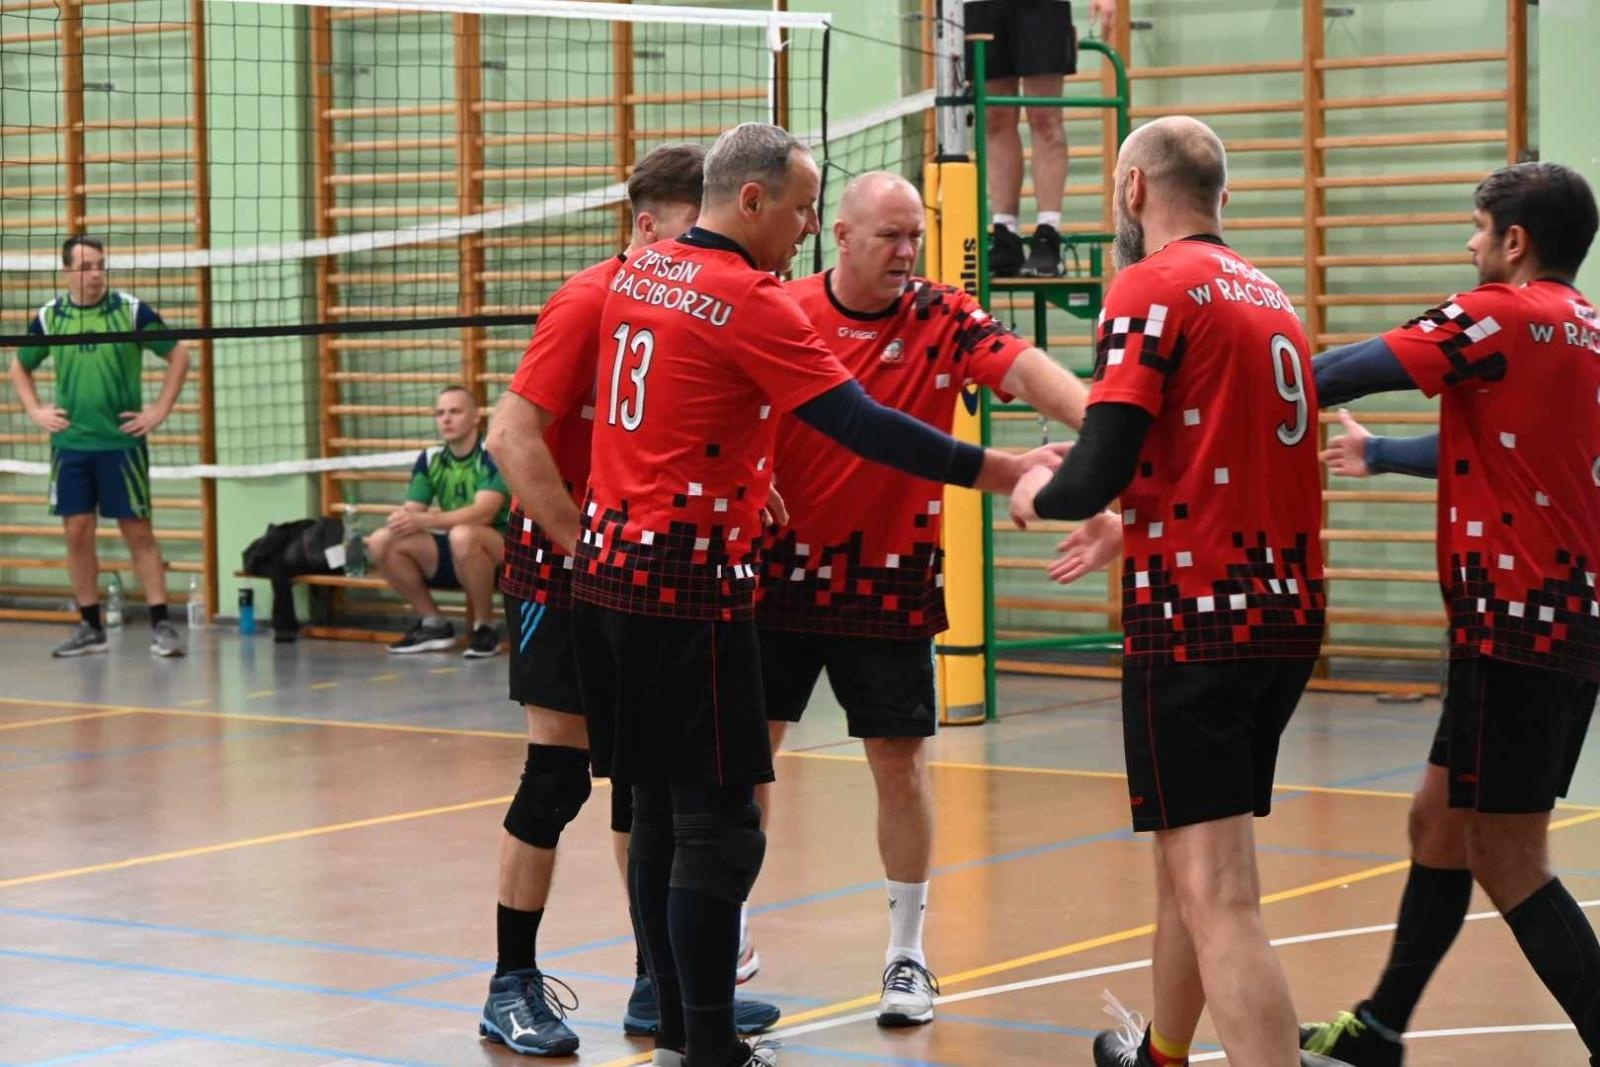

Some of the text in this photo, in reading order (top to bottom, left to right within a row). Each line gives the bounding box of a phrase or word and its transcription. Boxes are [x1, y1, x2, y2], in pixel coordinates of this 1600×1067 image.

[609, 268, 733, 327] RACIBORZU
[606, 321, 655, 432] 13
[1269, 332, 1309, 447] 9
